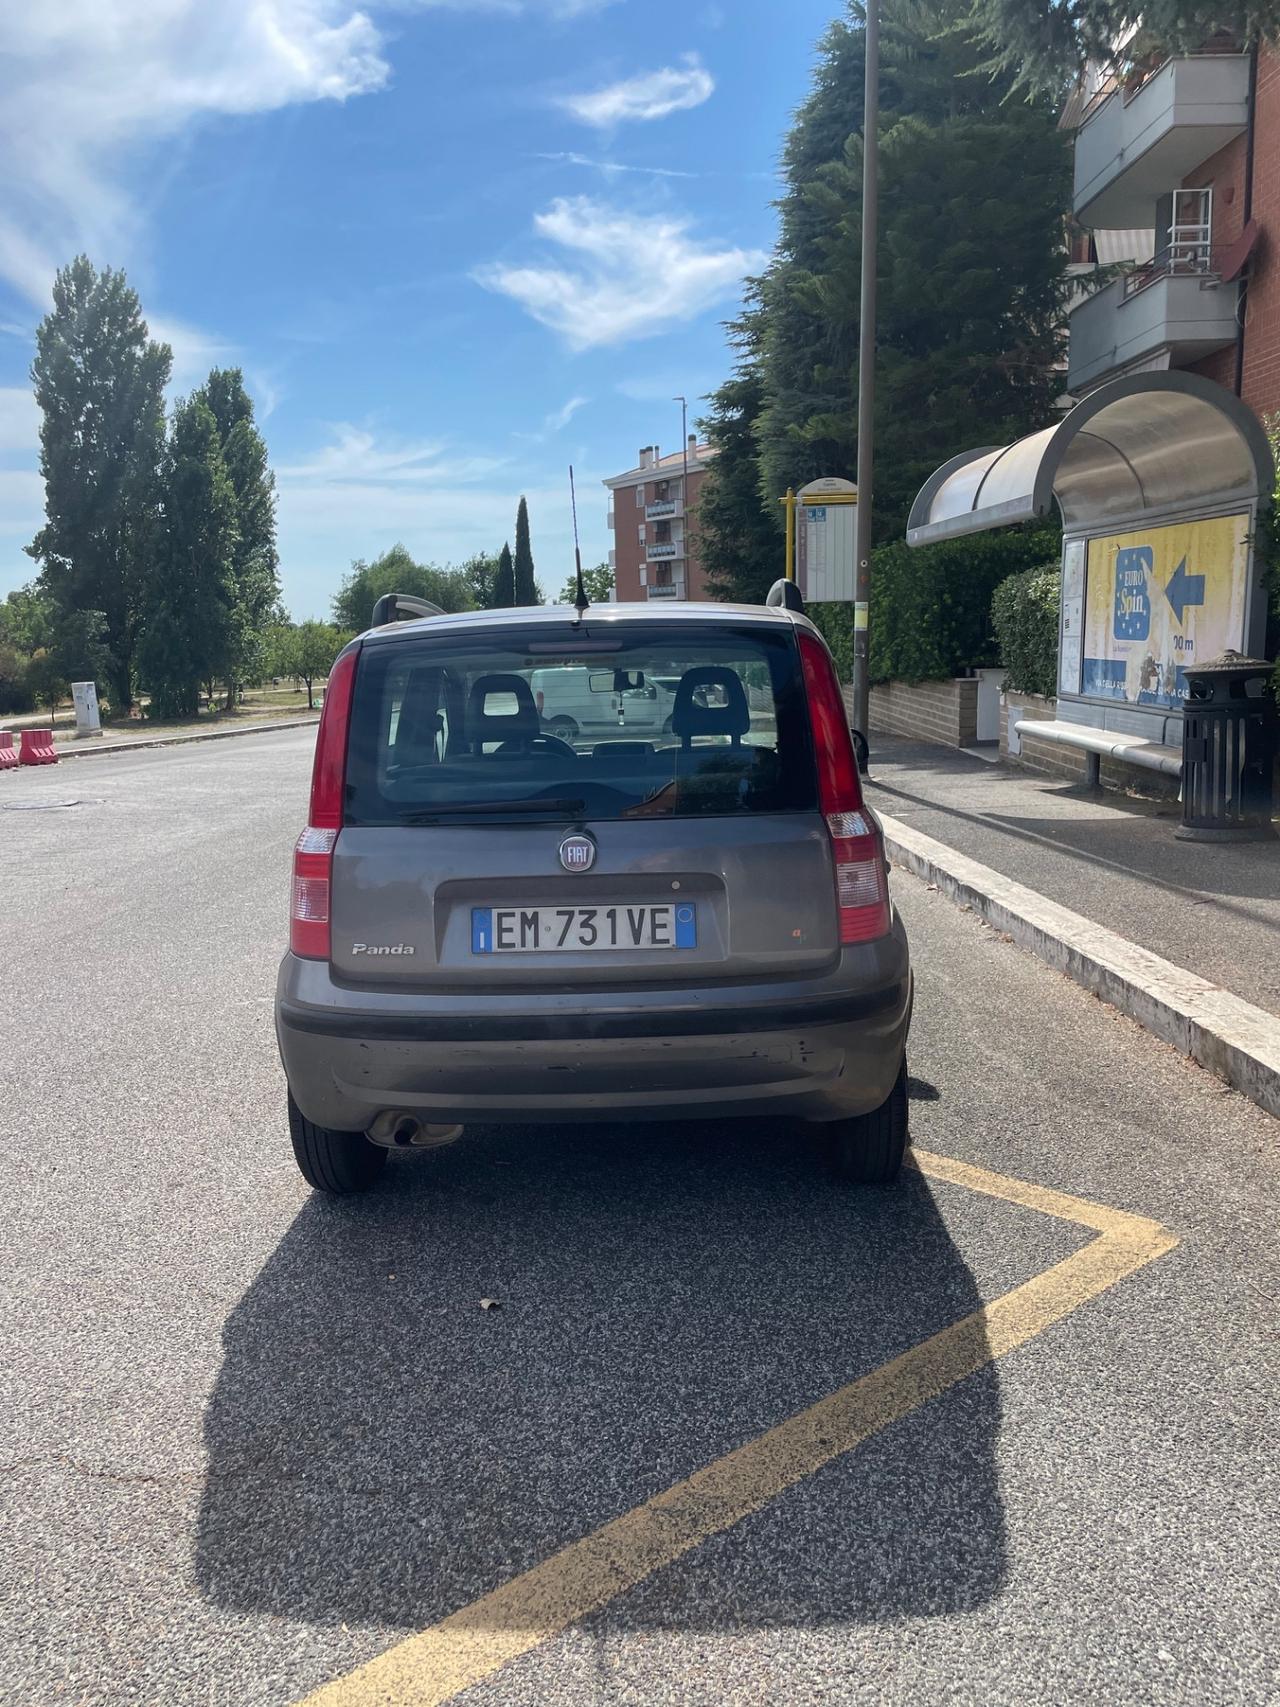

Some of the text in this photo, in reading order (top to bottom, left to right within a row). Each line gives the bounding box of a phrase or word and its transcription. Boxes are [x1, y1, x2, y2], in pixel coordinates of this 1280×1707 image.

[1124, 570, 1143, 586] EURO
[1120, 587, 1144, 620] Spin
[567, 846, 588, 862] FIAT
[496, 908, 671, 949] EM 731VE
[352, 943, 414, 955] Panda
